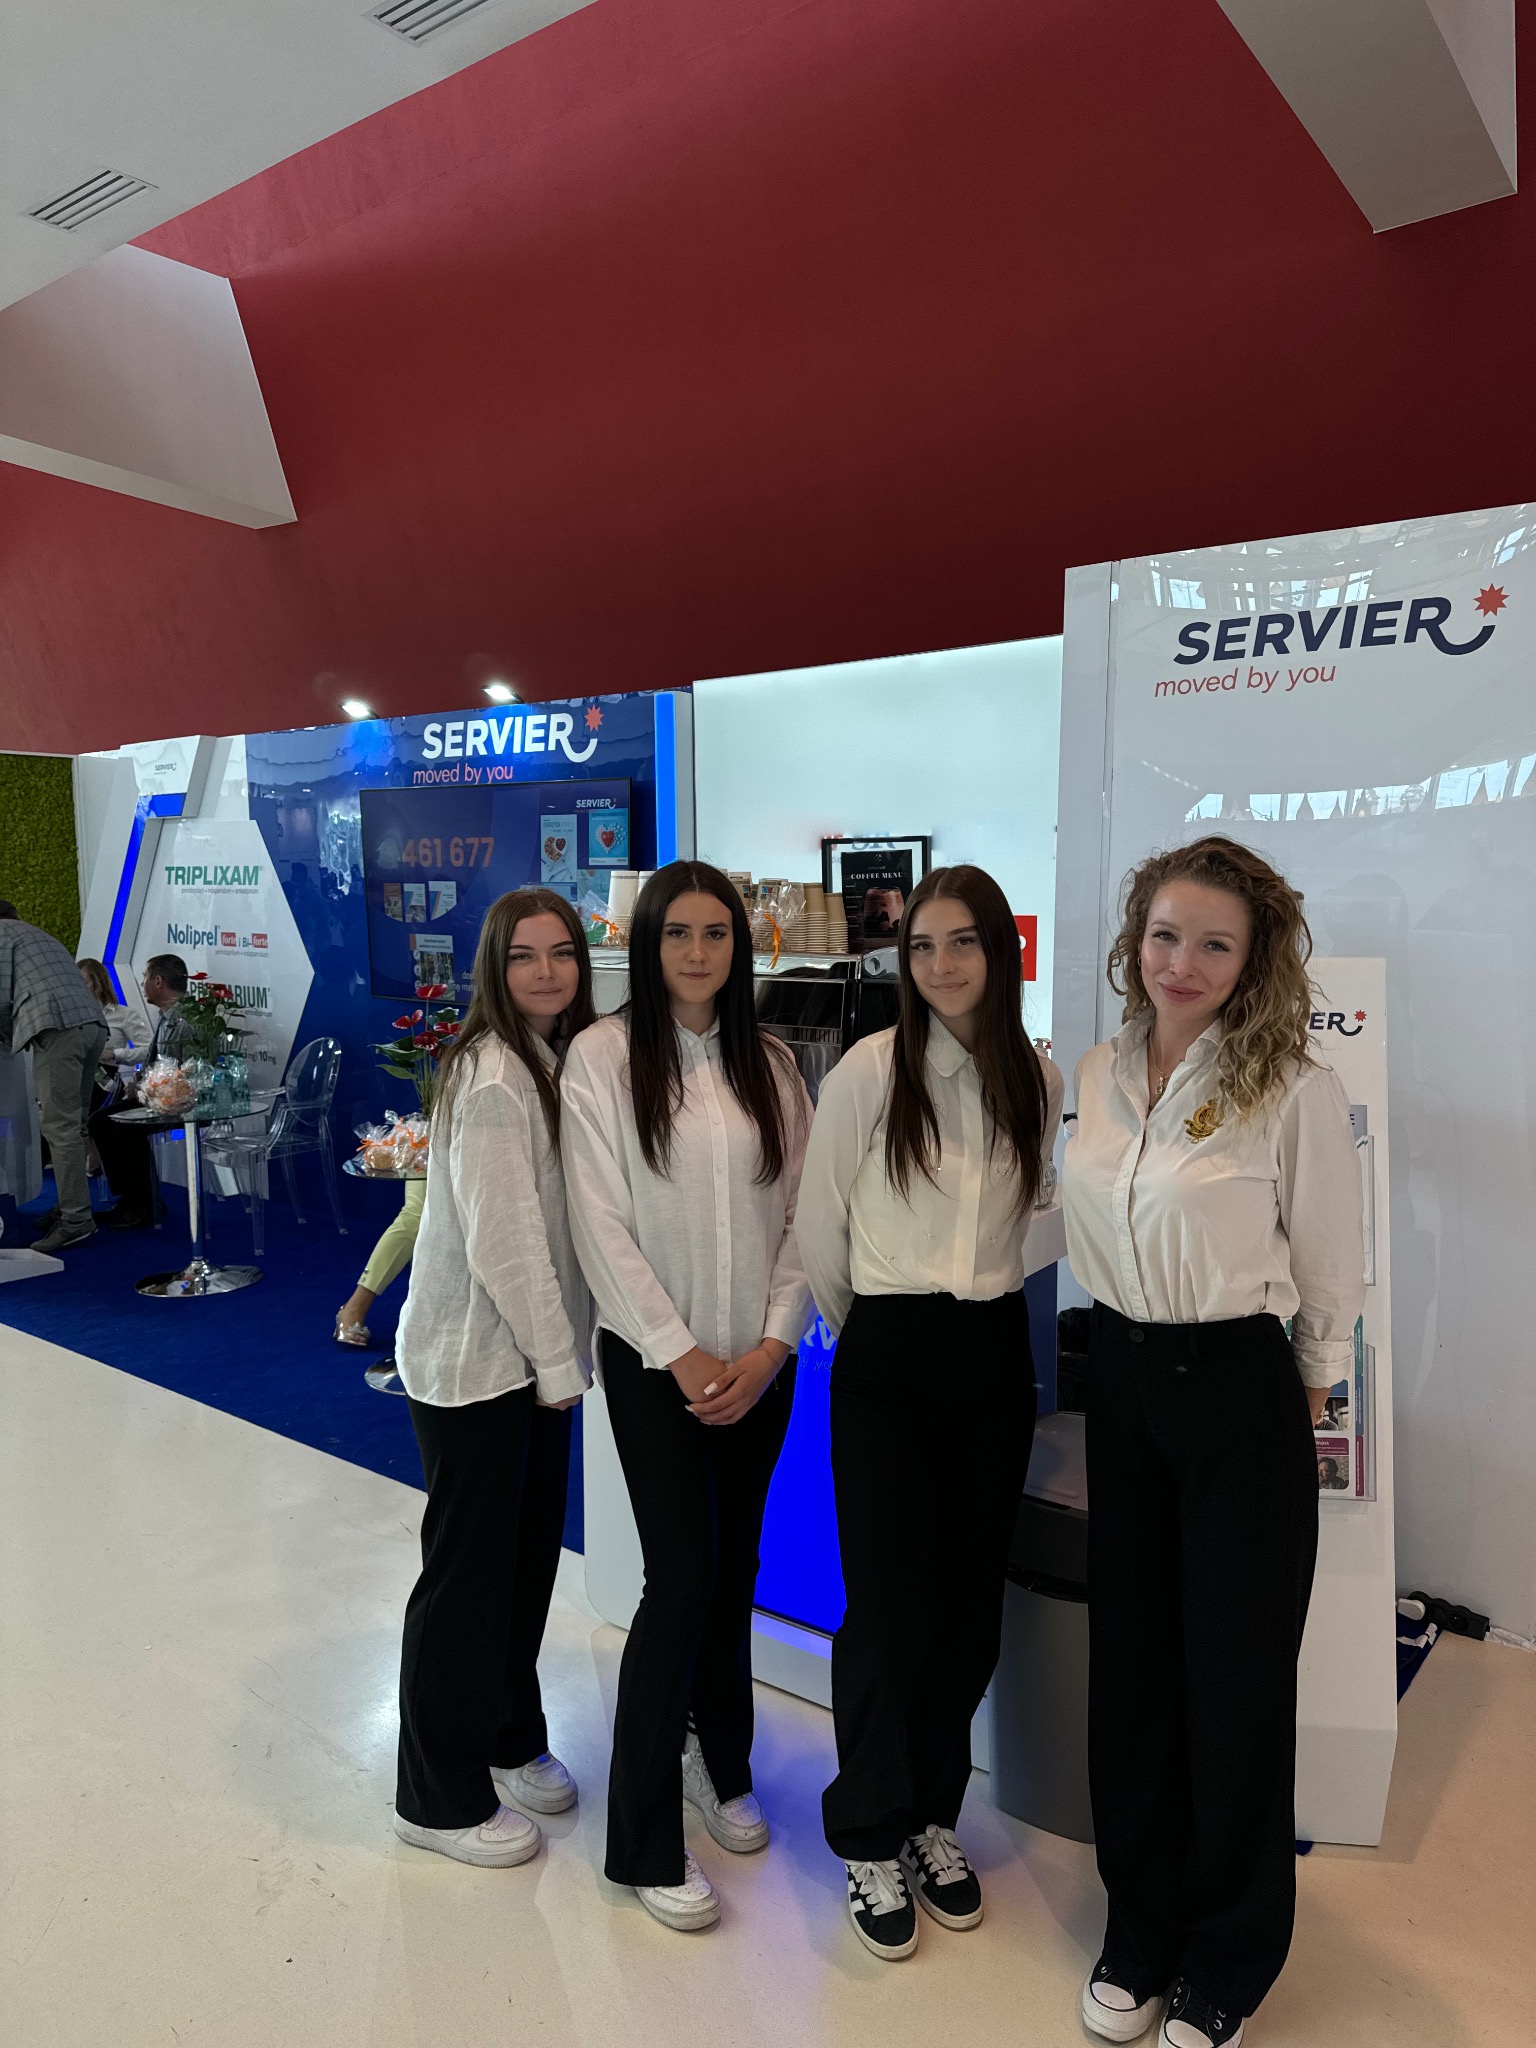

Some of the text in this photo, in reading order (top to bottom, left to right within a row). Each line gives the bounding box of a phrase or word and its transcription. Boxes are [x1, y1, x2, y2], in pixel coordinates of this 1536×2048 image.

[1173, 596, 1496, 665] SERVIER
[1154, 665, 1337, 698] moved by you
[421, 712, 598, 763] SERVIER
[413, 763, 514, 785] moved by you
[575, 798, 617, 809] SERVIER
[402, 836, 495, 868] 461 677
[164, 865, 260, 886] TRIPLIXAM
[850, 871, 902, 880] COFFEE MENU
[167, 923, 218, 950] Noliprel
